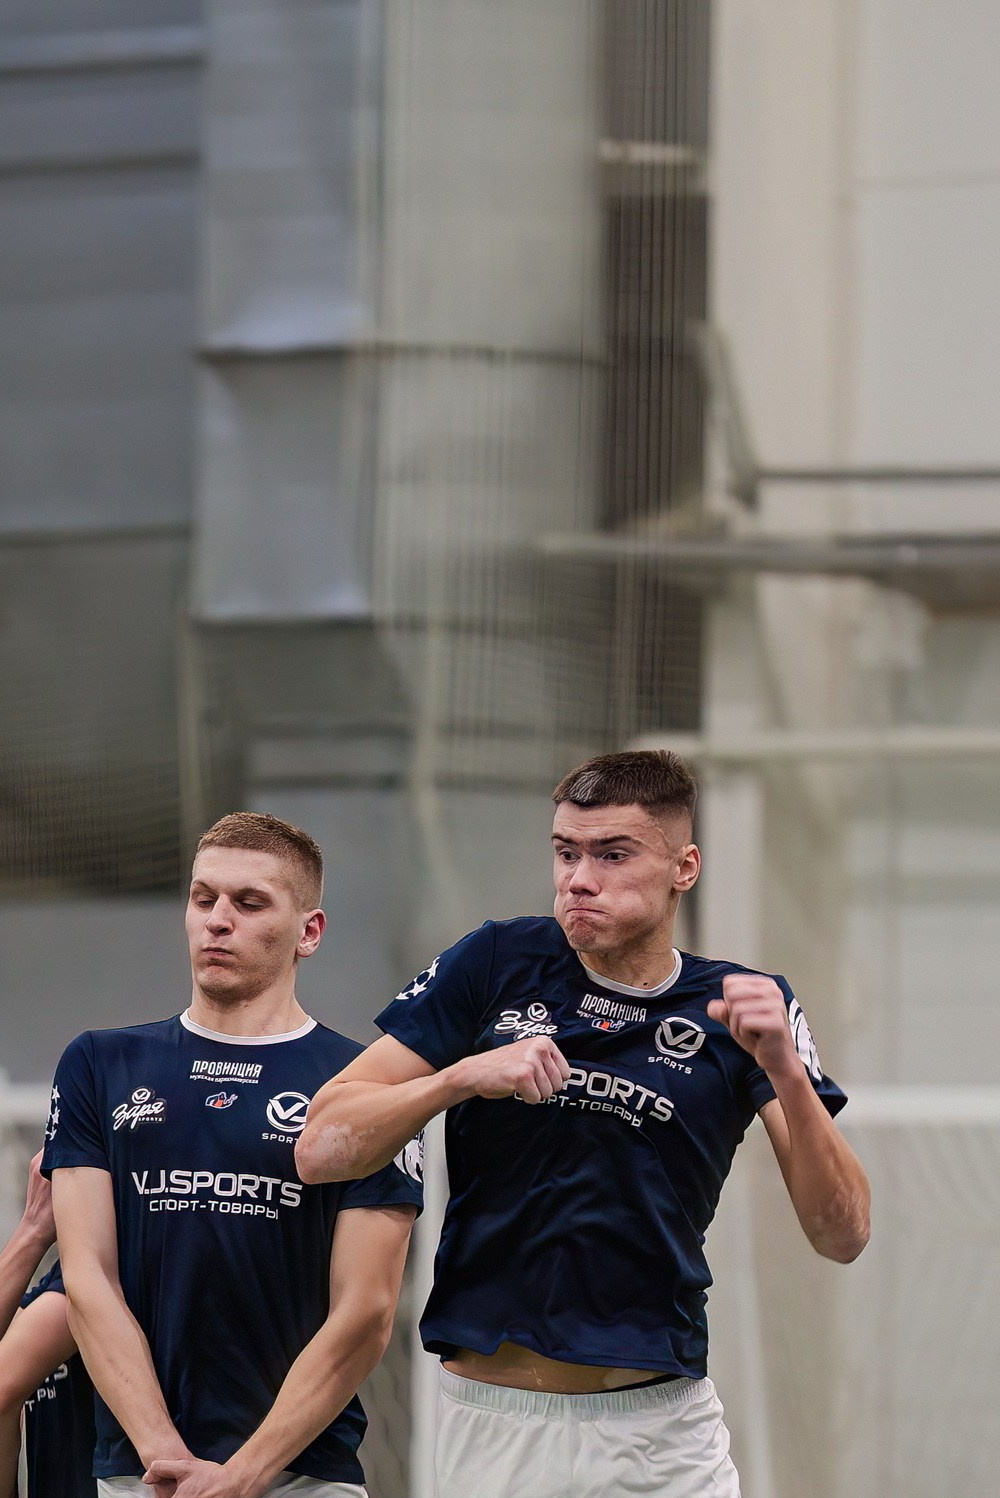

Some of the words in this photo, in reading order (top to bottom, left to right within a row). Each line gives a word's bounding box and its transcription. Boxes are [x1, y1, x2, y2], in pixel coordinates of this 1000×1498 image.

[580, 993, 648, 1023] ПРОВИНЦИЯ
[191, 1060, 263, 1078] ПРОВИНЦИЯ
[647, 1055, 693, 1075] SPORTS
[562, 1067, 675, 1122] PORTS
[111, 1101, 165, 1131] Заря
[261, 1132, 298, 1144] SPOR
[131, 1169, 303, 1207] V.J.SPORTS
[149, 1199, 279, 1220] СПОРТ-ТОВАРЫ
